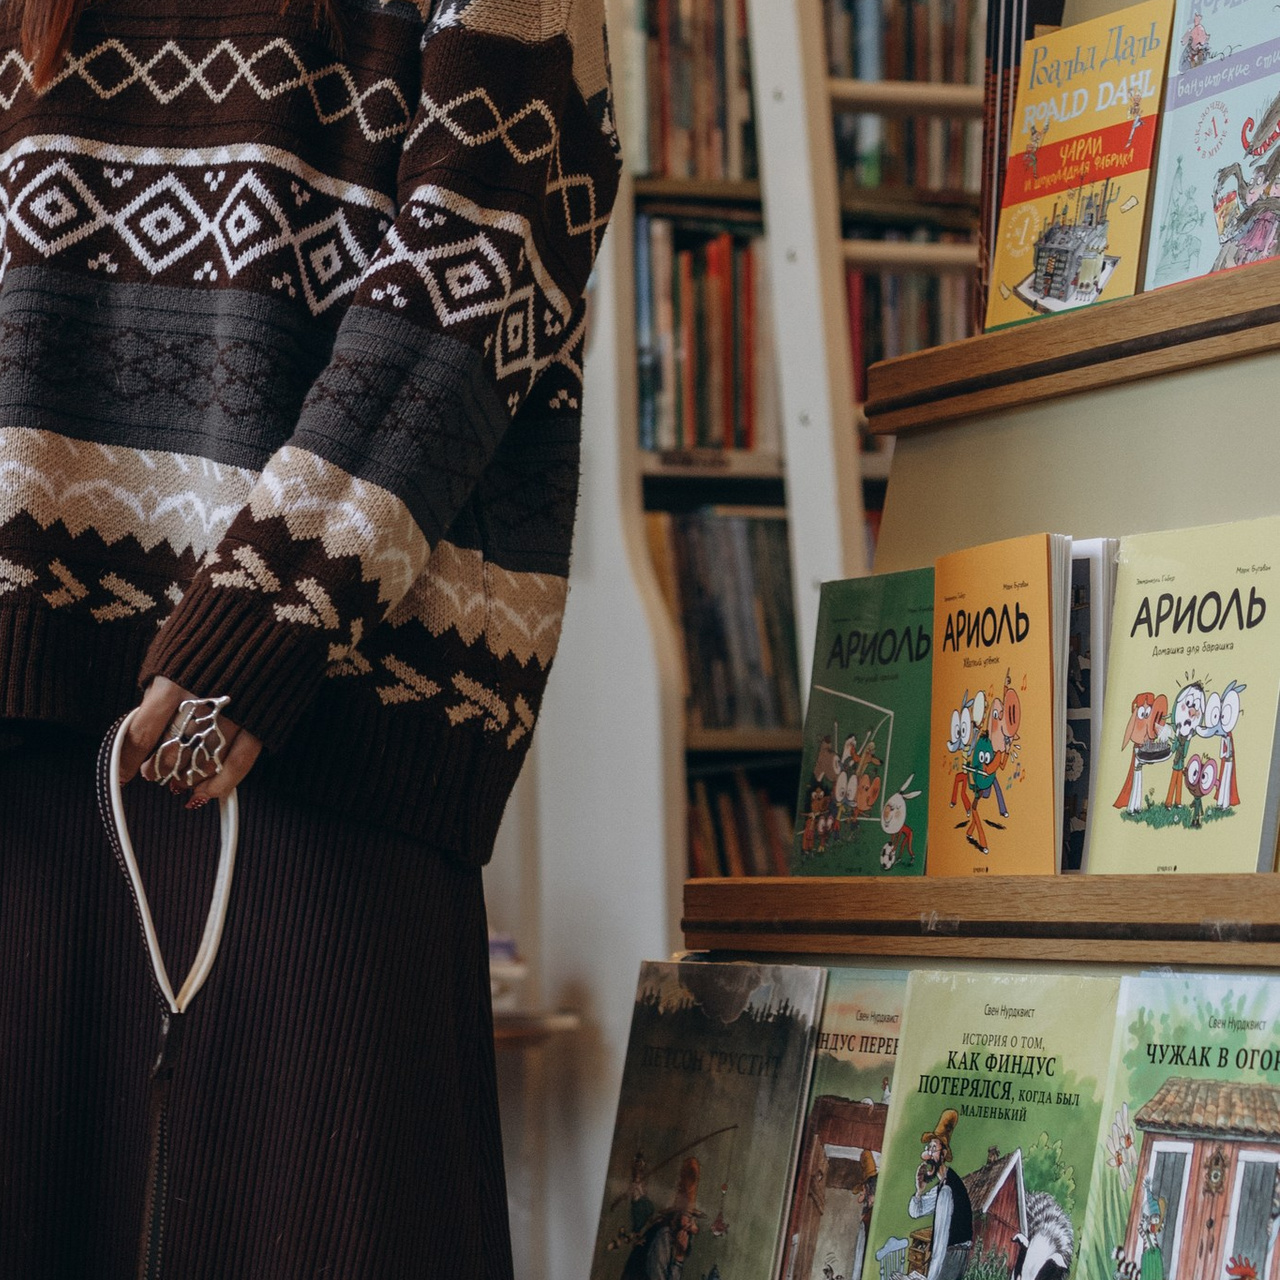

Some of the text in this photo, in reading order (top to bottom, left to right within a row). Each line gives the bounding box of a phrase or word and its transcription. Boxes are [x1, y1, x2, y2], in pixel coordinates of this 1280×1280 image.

[1029, 22, 1160, 91] Роальд Даль
[1022, 69, 1156, 134] ROALD DAHL
[1060, 136, 1103, 167] ЧАРЛИ
[1094, 148, 1135, 170] ФАБРИКА
[1130, 586, 1266, 638] АРИОЛЬ
[943, 602, 1029, 652] АРИОЛЬ
[826, 624, 931, 669] АРИОЛЬ
[1152, 645, 1184, 657] Домашка
[1186, 644, 1200, 656] для
[984, 1004, 1035, 1019] Свен Нурдквист
[1208, 1015, 1267, 1033] Свен Нурдквист
[817, 1032, 856, 1053] НДУС
[962, 1033, 1045, 1051] ИСТОРИЯ О ТОМ,
[946, 1051, 1056, 1079] КАК ФИНДУС
[1146, 1043, 1212, 1067] ЧУЖАК
[1217, 1047, 1229, 1068] В
[917, 1075, 1080, 1106] ПОТЕРЯЛСЯ, КОГДА БЫЛ
[960, 1104, 1027, 1121] МАЛЕНЬКИЙ
